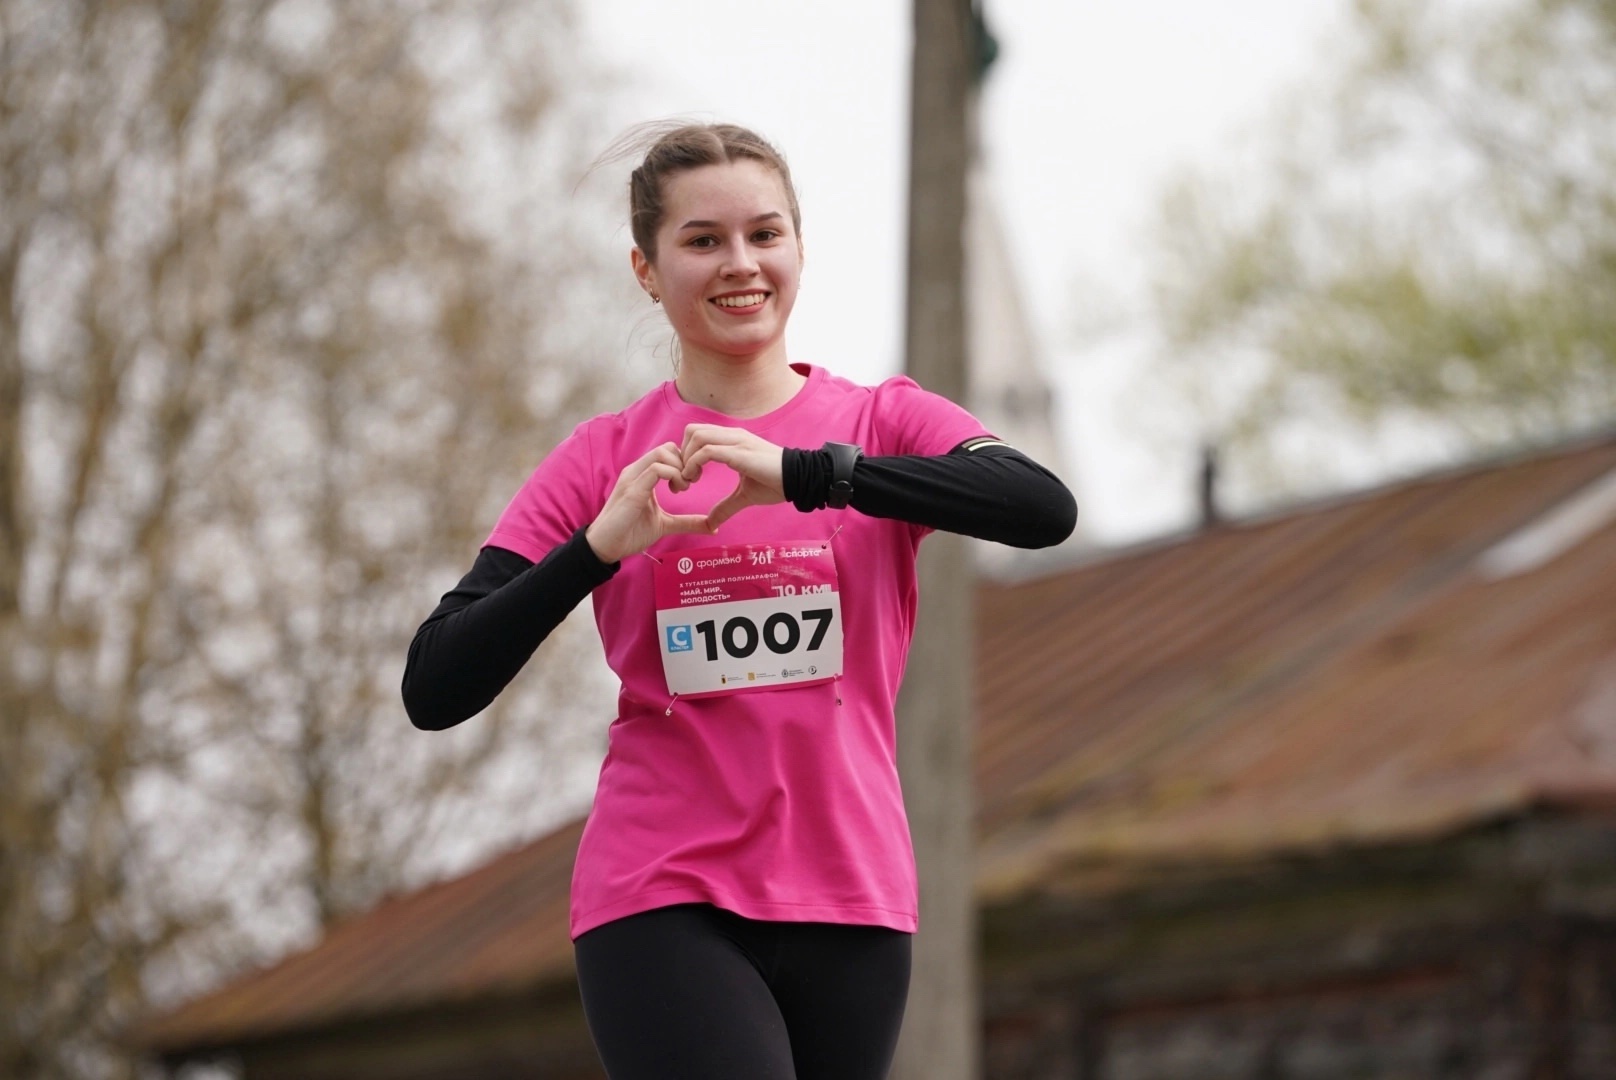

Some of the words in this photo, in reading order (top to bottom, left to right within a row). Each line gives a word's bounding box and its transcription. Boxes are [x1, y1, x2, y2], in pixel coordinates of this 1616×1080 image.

[685, 577, 726, 587] ТУТАЕВСКИЙ
[727, 572, 779, 582] ПОЛУМАРАФОН
[703, 586, 722, 594] МИР.
[680, 594, 731, 604] МОЛОДОСТЬ»
[695, 608, 833, 661] 1007
